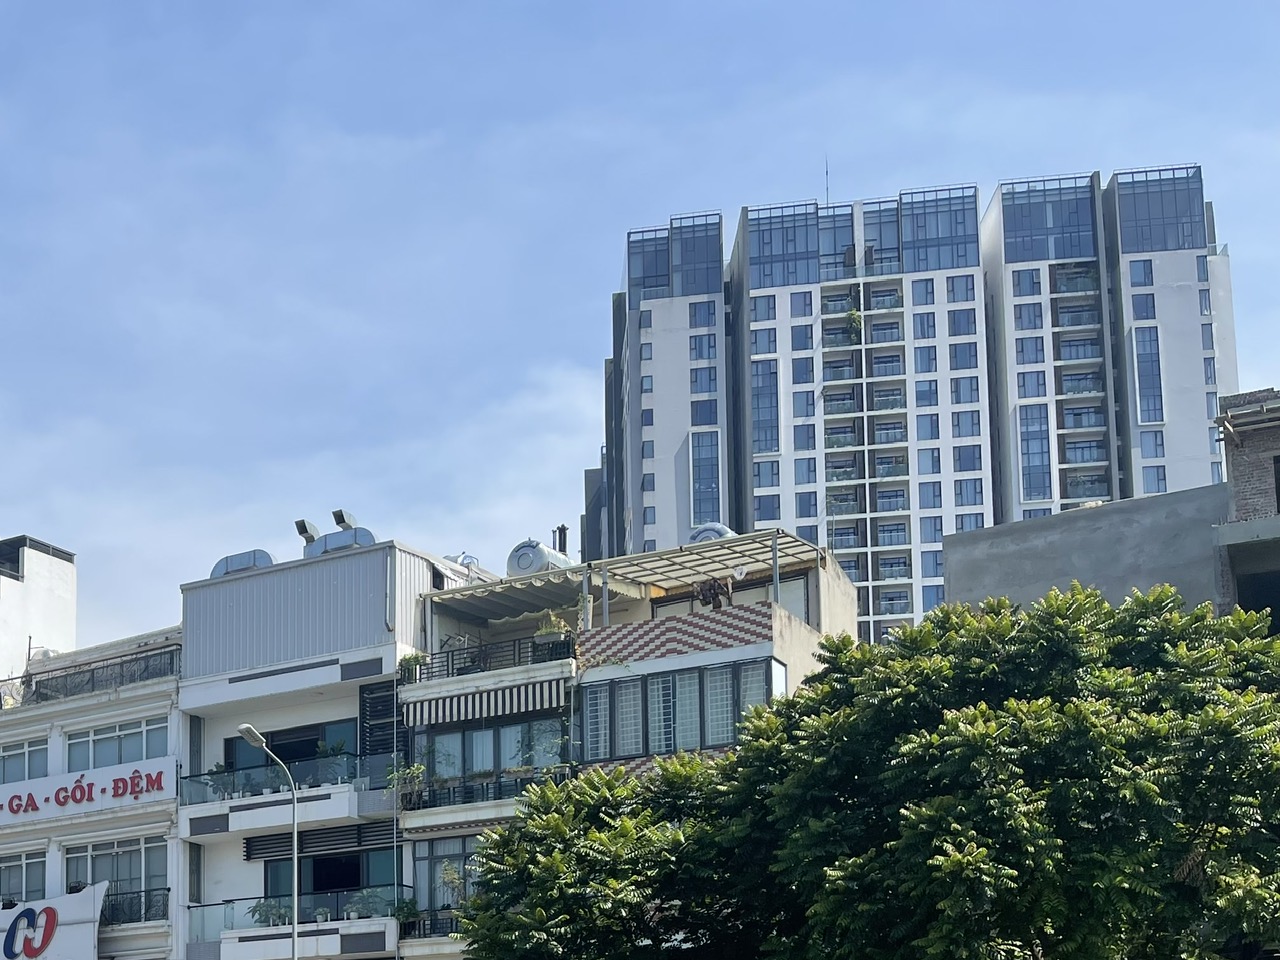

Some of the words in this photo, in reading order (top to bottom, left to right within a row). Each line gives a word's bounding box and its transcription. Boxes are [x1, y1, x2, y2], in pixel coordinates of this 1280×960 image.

[8, 793, 39, 814] GA
[54, 774, 95, 806] GỐI
[112, 769, 164, 800] ĐỆM
